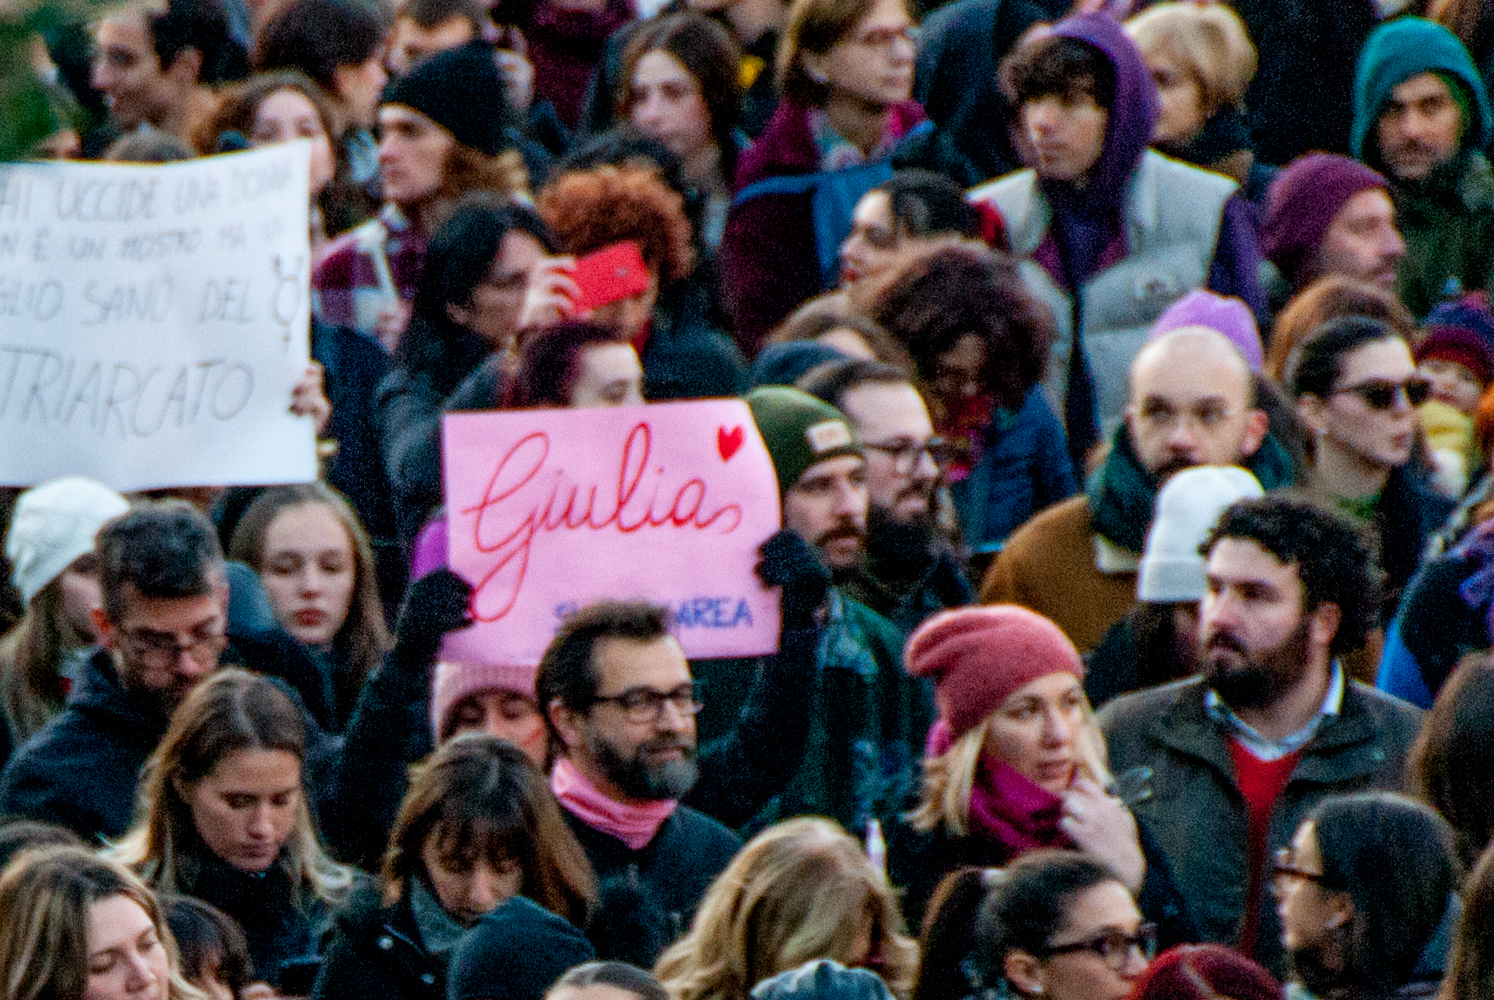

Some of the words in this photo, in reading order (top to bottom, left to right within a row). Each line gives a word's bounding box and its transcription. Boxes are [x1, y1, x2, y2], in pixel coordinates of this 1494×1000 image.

[55, 177, 158, 222] UCCIDE
[173, 177, 222, 216] UNA
[68, 234, 110, 263] UN
[120, 227, 204, 262] MOSTRO
[80, 273, 174, 327] SANO
[198, 275, 256, 326] DEL
[460, 421, 742, 624] Giulia
